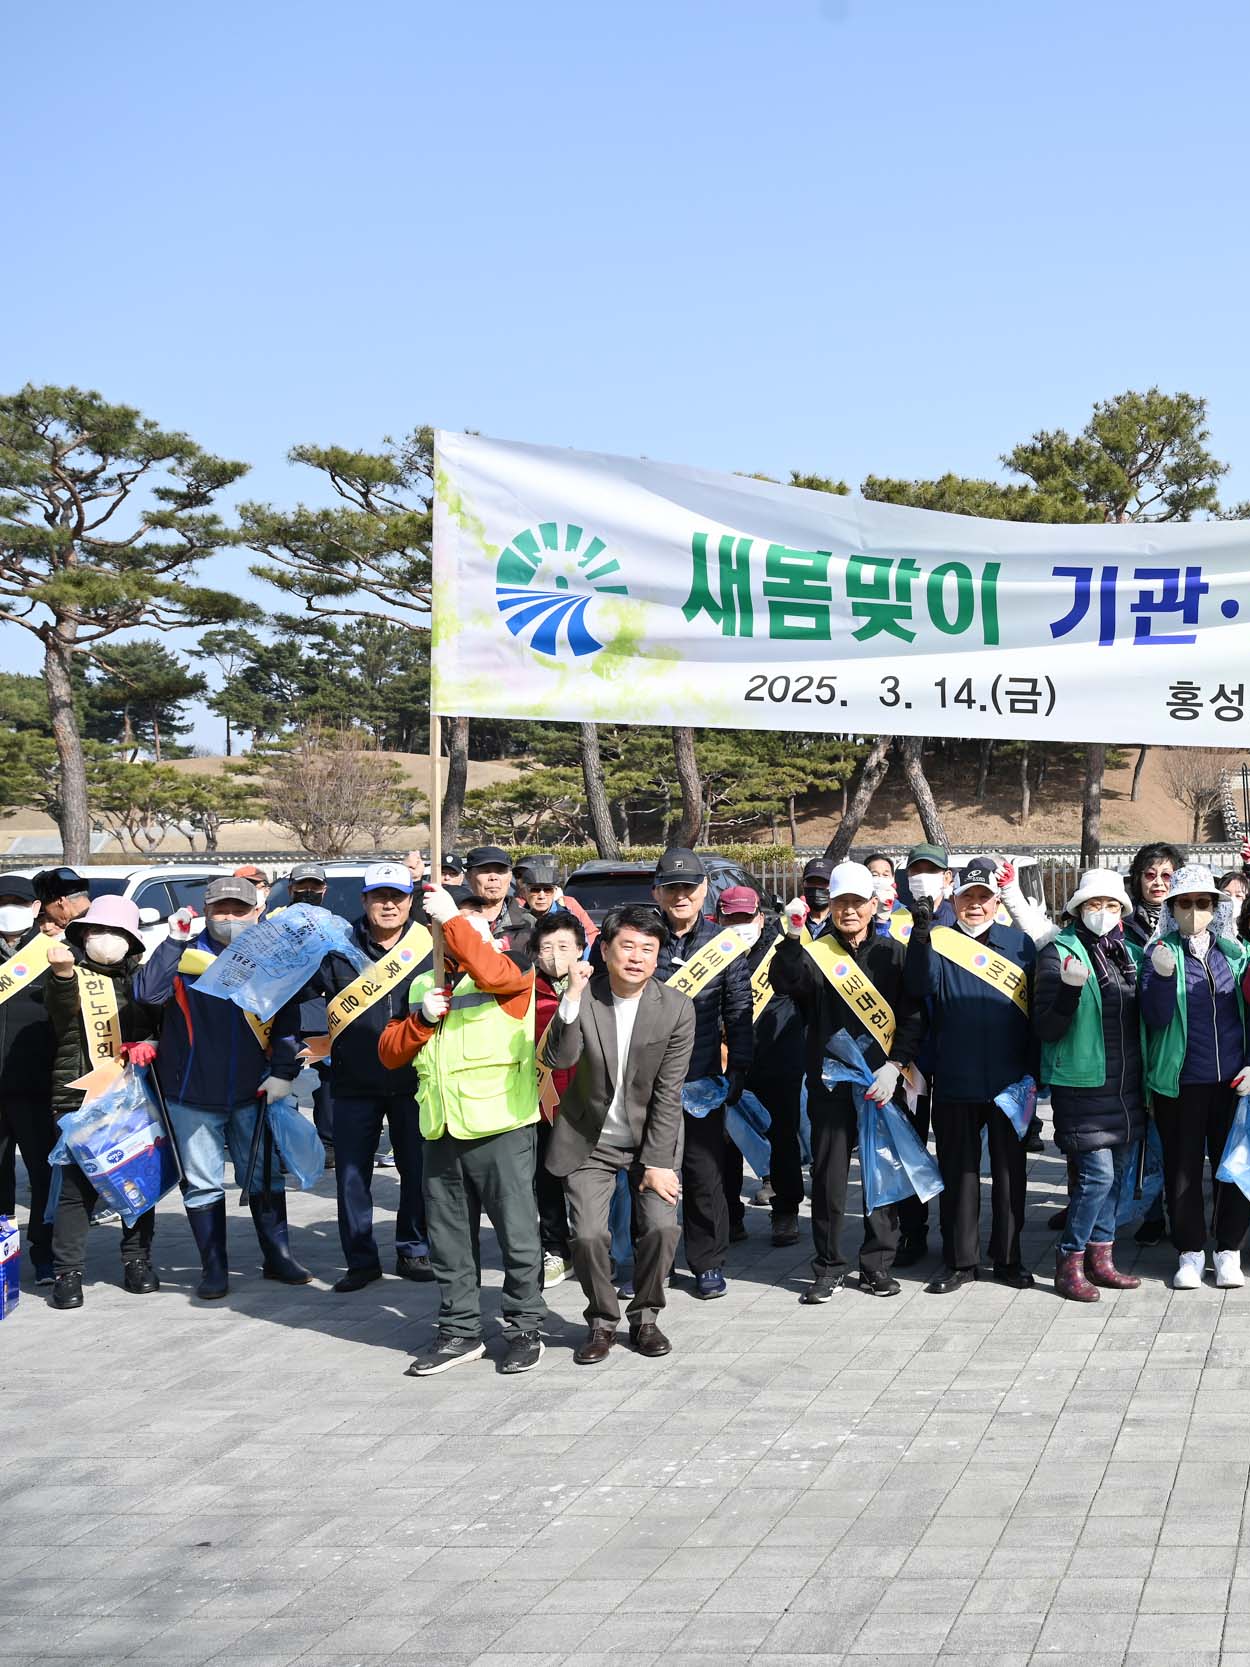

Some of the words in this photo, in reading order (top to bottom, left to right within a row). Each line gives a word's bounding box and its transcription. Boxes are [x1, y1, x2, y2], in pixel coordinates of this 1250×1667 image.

[682, 532, 1001, 646] 새봄맞이
[743, 674, 849, 707] 2025.
[879, 675, 913, 709] 3.
[934, 674, 1057, 717] 14.(금)
